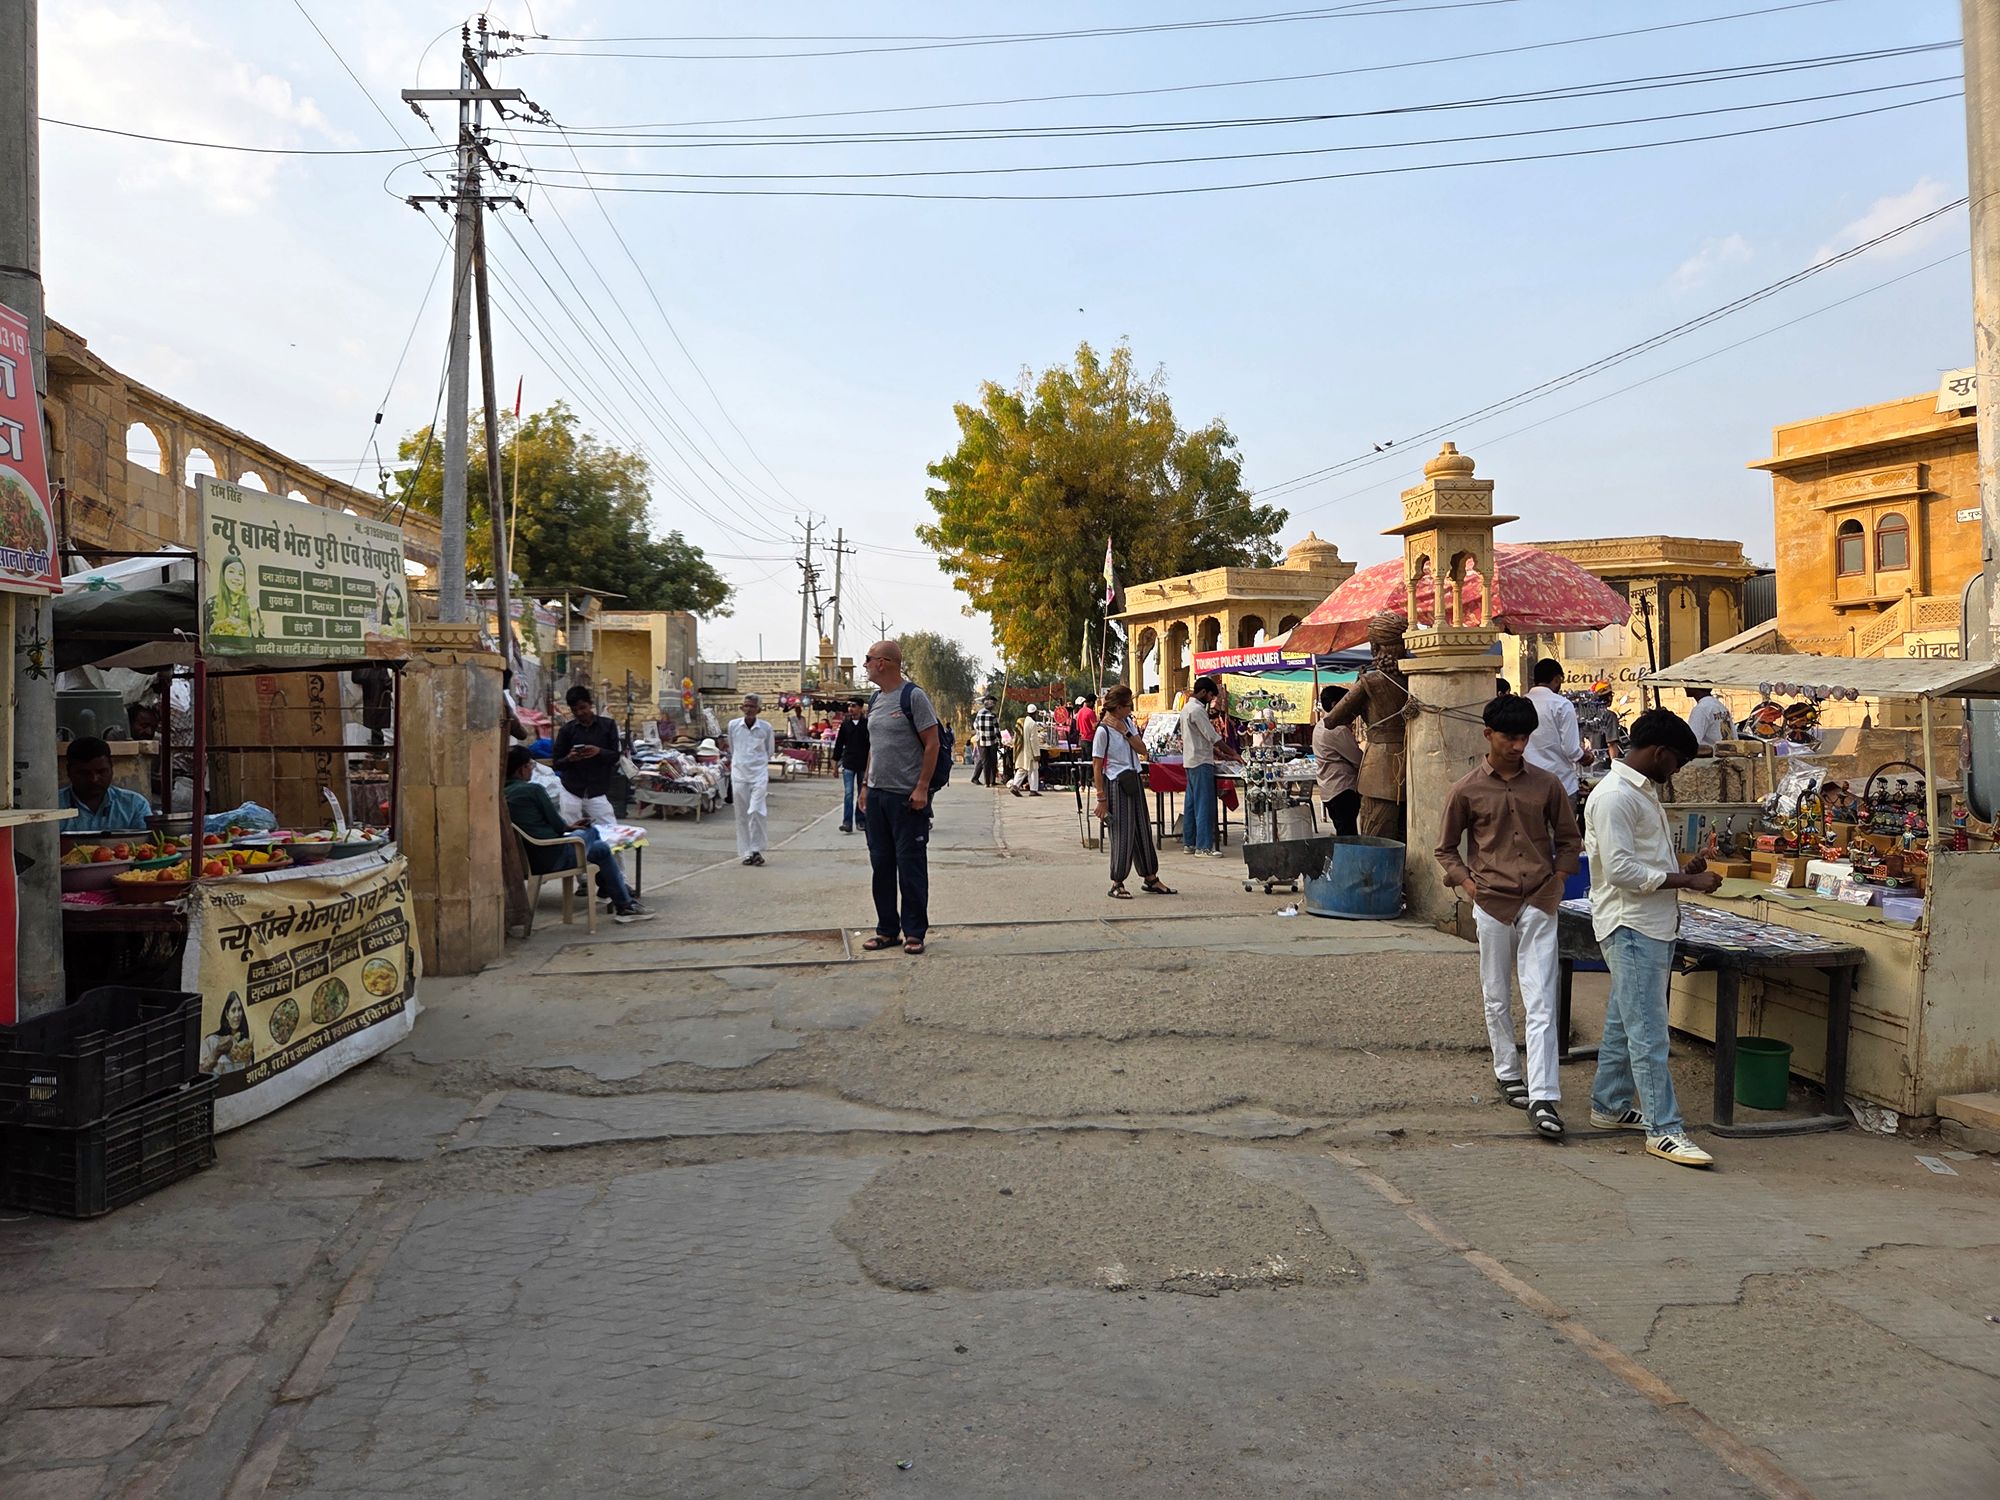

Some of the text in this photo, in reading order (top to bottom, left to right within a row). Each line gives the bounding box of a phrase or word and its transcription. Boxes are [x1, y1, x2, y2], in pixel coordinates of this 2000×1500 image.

[210, 484, 242, 503] राम सिंह
[211, 515, 241, 556] न्यू
[239, 520, 280, 553] बाम्बे
[284, 524, 311, 558] भेल
[314, 533, 339, 569] पुरी
[362, 541, 401, 580] सेवपुरी
[25, 549, 50, 575] मेगी
[1630, 586, 1656, 599] मसाला
[255, 642, 276, 654] शादी
[1196, 656, 1220, 670] TOURIST
[1220, 654, 1242, 668] POLICE
[1242, 652, 1280, 666] JAISALMER
[218, 924, 254, 962] न्यू
